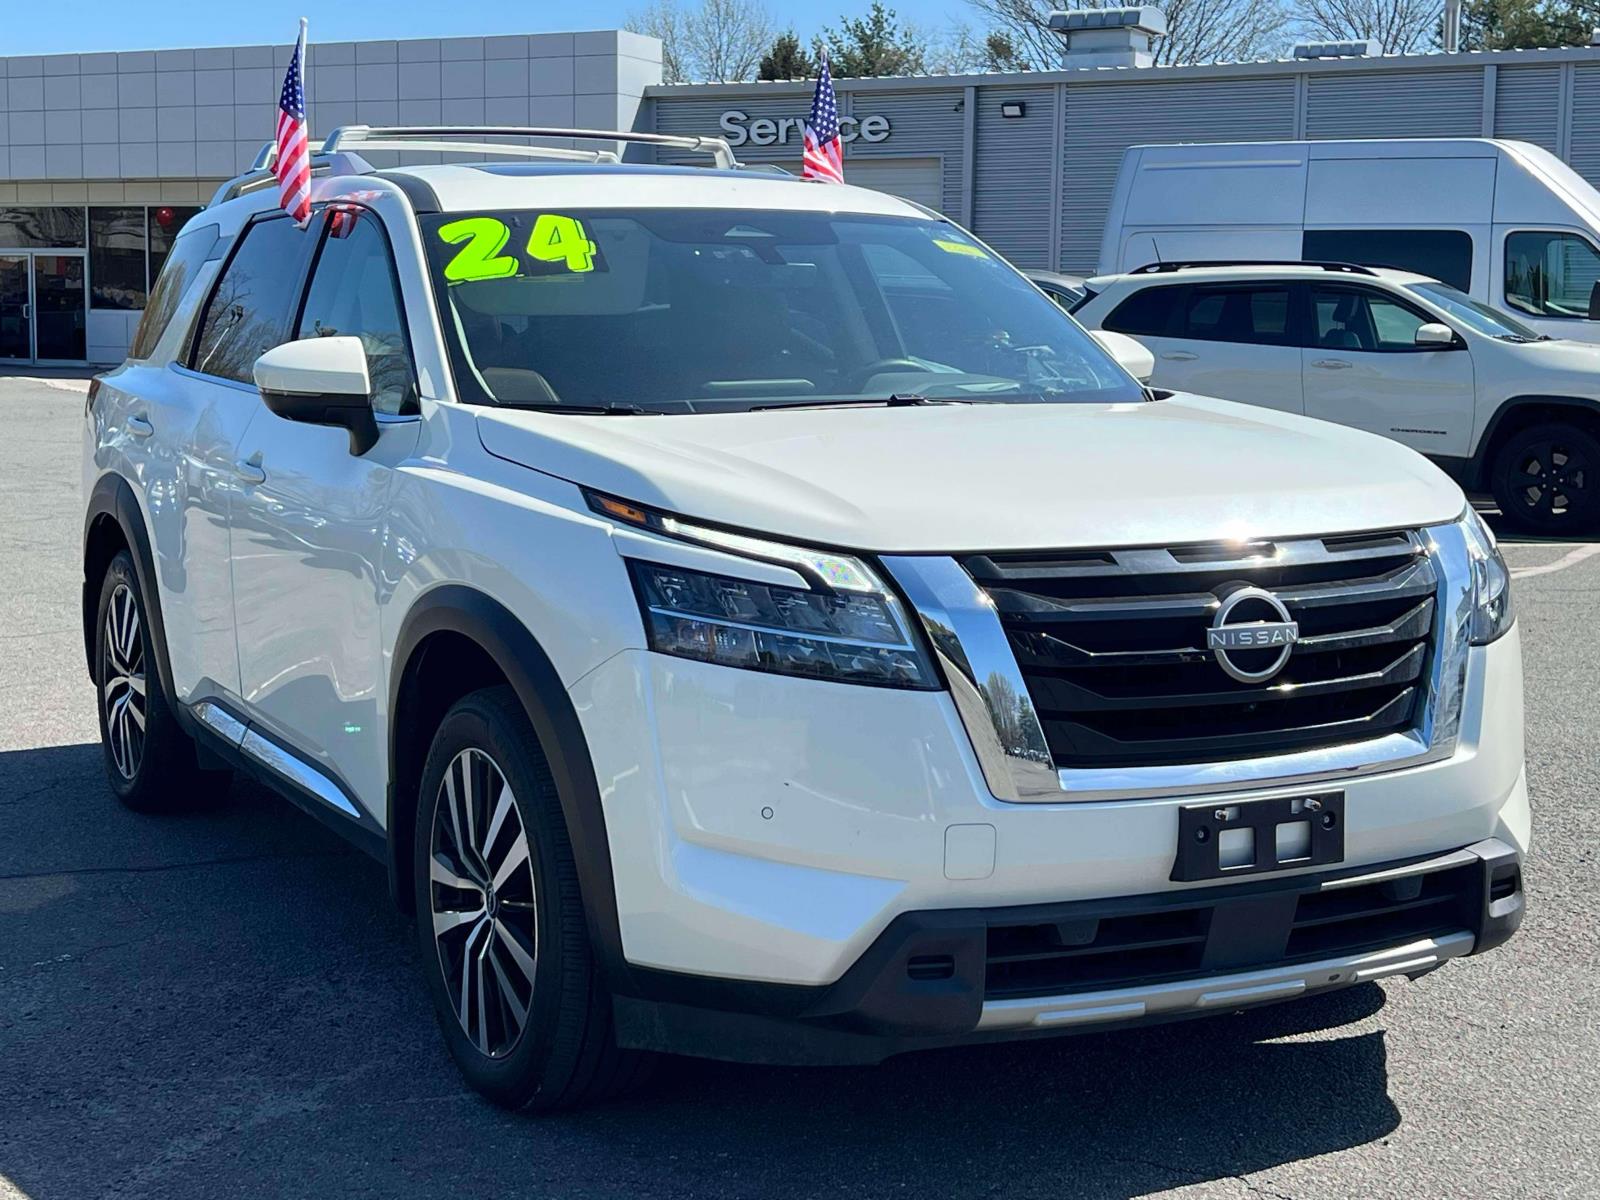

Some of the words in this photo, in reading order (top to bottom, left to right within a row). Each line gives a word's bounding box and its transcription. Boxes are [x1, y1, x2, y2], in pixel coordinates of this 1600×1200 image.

[719, 110, 892, 147] Serce
[438, 213, 597, 283] 24
[1210, 627, 1298, 646] NISSAN
